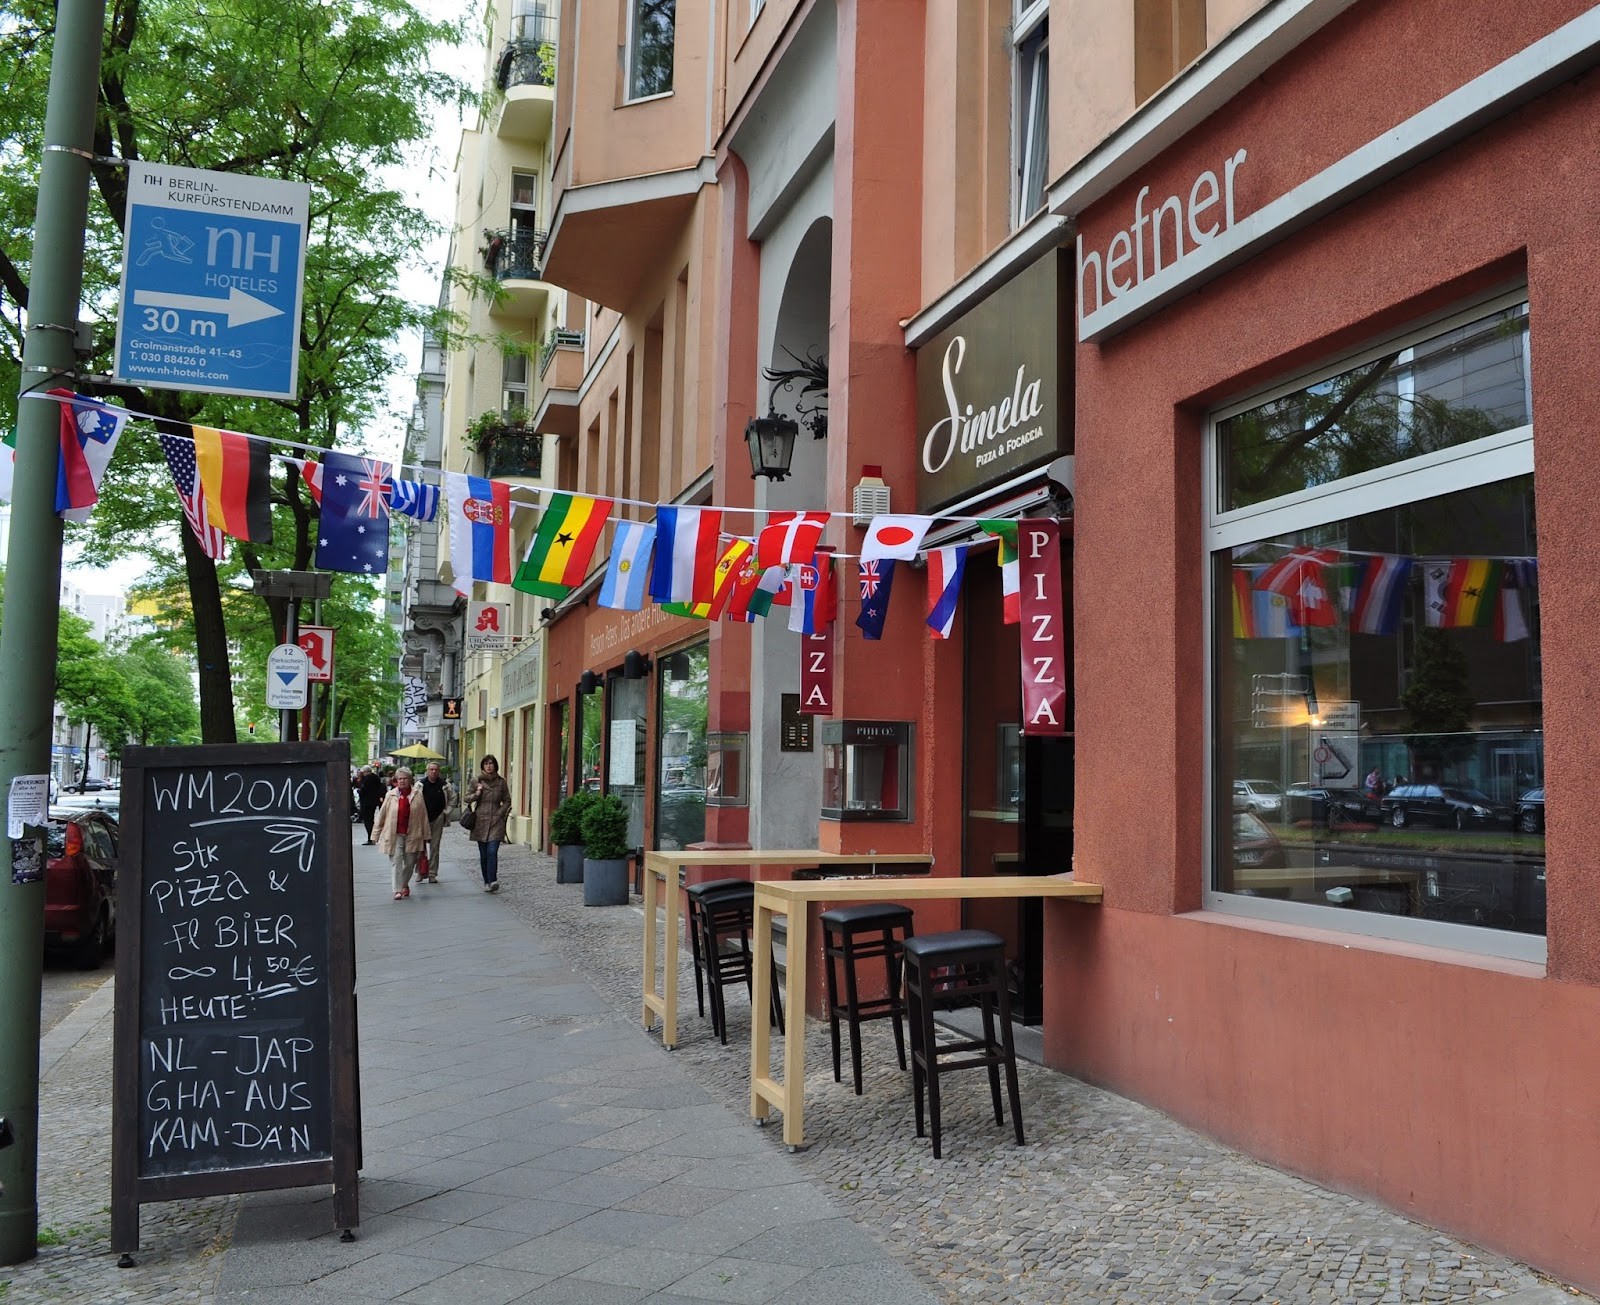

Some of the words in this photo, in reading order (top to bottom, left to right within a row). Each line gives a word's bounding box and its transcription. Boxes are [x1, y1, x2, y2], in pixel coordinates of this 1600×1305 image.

[169, 178, 218, 193] BERLIN-
[168, 191, 293, 216] KURFÜRSTENDAMM
[1076, 148, 1247, 318] hefner
[205, 274, 278, 293] HOTELES
[142, 308, 180, 333] 30
[190, 319, 217, 337] m
[129, 351, 138, 360] T.
[141, 353, 161, 362] 030
[163, 354, 196, 365] 88426
[199, 357, 206, 366] 0
[130, 339, 206, 355] Grolmanstraße
[128, 364, 229, 381] www.nh-hotels.com
[922, 335, 1044, 474] Simela
[975, 449, 997, 468] PIZZA
[997, 444, 1004, 456] &
[1028, 531, 1059, 725] PIZZA
[284, 648, 294, 656] 12
[172, 838, 219, 872] Stk
[268, 869, 290, 893] &
[150, 1037, 198, 1073] NL
[235, 1035, 314, 1076] JAP
